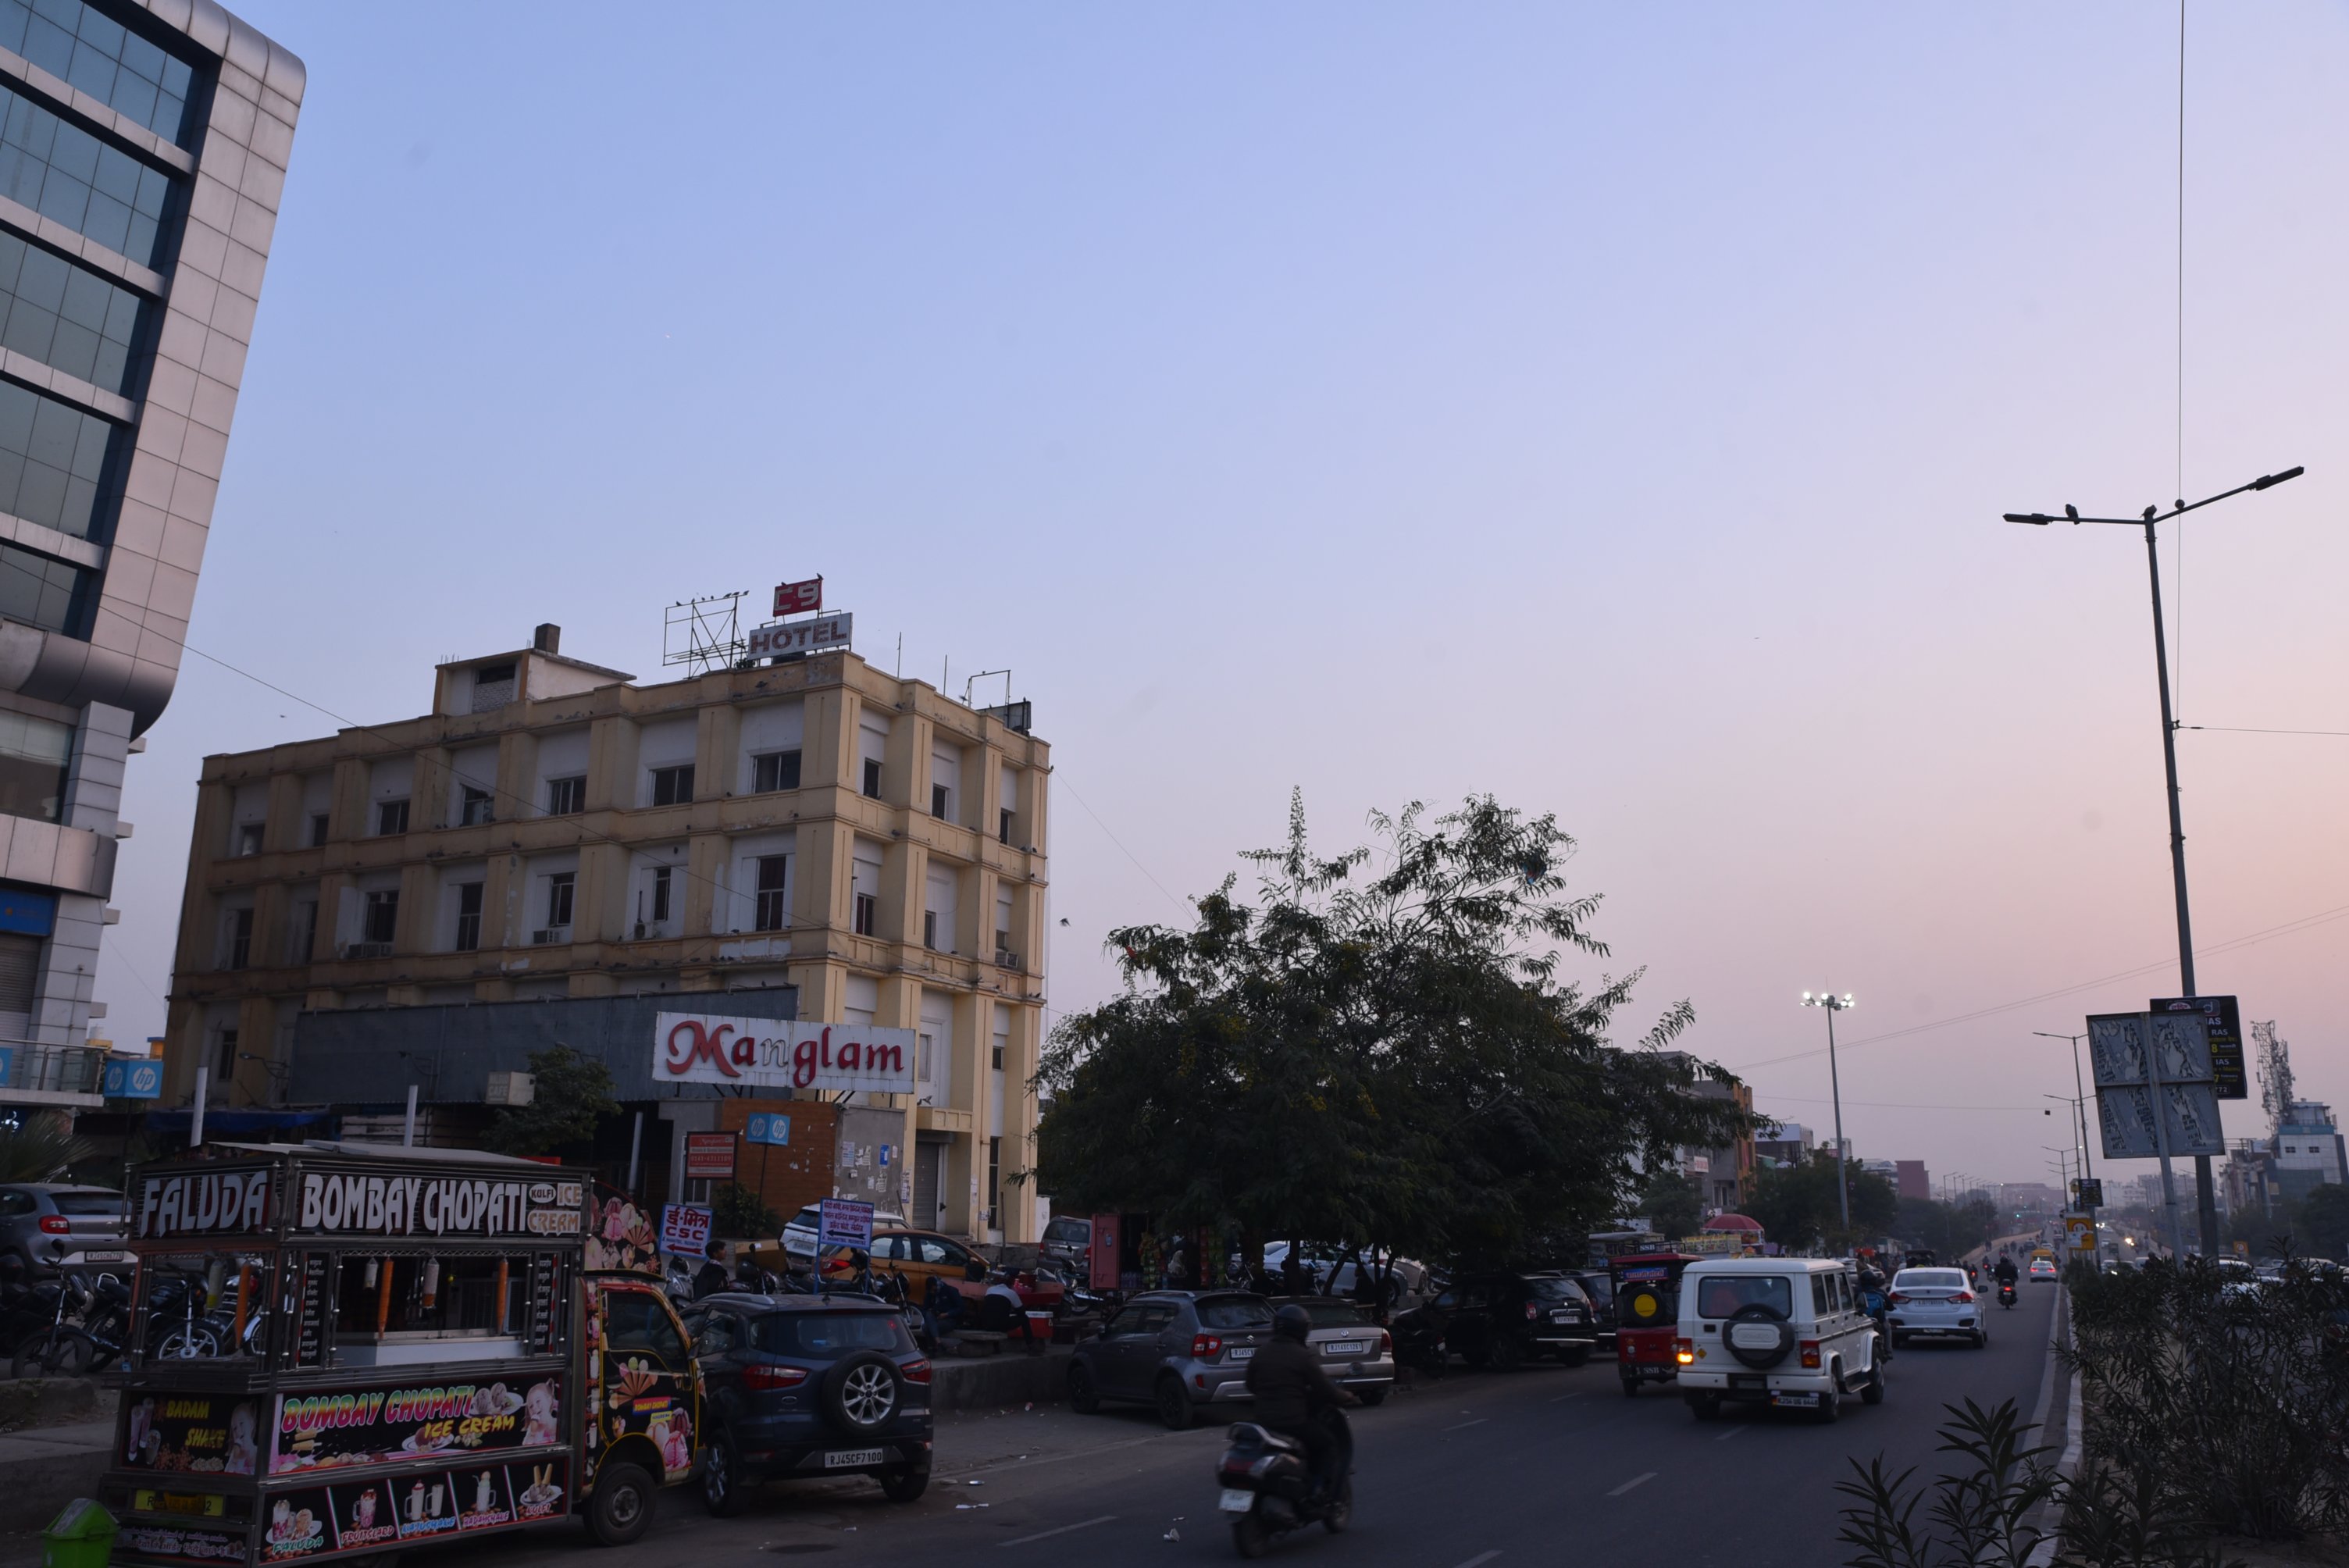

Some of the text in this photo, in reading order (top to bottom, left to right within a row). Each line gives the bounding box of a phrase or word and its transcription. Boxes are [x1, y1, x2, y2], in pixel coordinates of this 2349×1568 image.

[750, 621, 847, 654] HOTEL
[666, 1021, 904, 1089] Manglam
[109, 1067, 122, 1089] hp
[135, 1067, 155, 1090] hp
[752, 1118, 765, 1136] hp
[774, 1120, 785, 1138] hp
[531, 1188, 554, 1199] KULFI
[558, 1185, 581, 1205] ICE
[141, 1171, 268, 1238] FALUDA
[301, 1174, 527, 1236] BOMBAY CHOPATI
[528, 1212, 579, 1233] CREAM
[666, 1226, 704, 1240] CSC
[166, 1400, 211, 1420] BADAM
[281, 1385, 476, 1433] BOMBAY CHOPATI
[423, 1415, 515, 1438] ICE CREAM
[185, 1427, 226, 1449] SHAKE
[830, 1452, 882, 1466] RJ45CF7100
[273, 1536, 324, 1554] FALUDA
